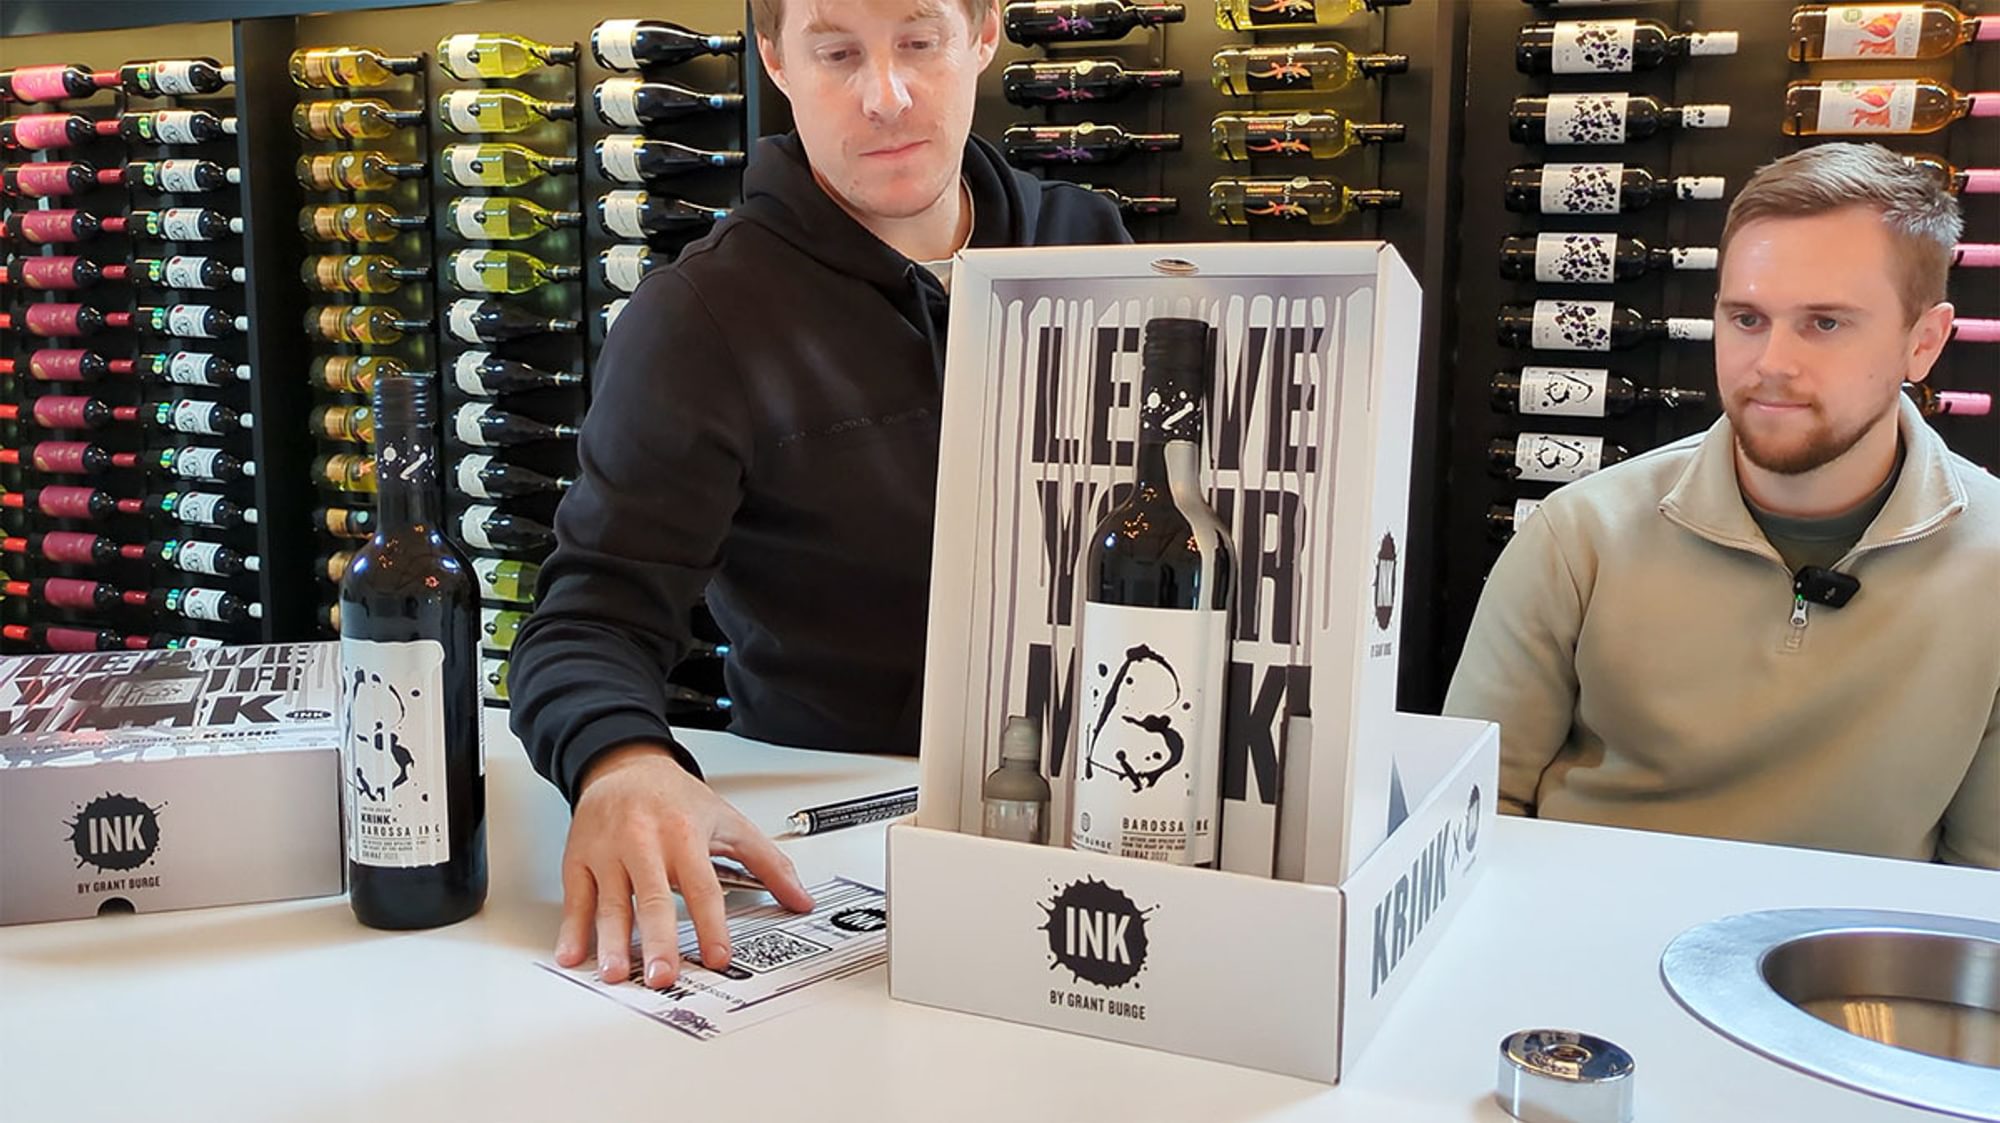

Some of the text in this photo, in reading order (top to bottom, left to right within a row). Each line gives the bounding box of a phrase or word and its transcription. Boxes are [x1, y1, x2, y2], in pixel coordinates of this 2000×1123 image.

[1032, 327, 1324, 472] LEVE
[1037, 480, 1305, 646] YR
[1025, 643, 1288, 806] MK
[89, 814, 147, 855] INK
[361, 813, 392, 825] KRINK
[361, 824, 412, 837] BAROSSA
[1122, 817, 1185, 832] BAROSSA
[77, 876, 161, 894] BY GRANT BURGE
[838, 911, 883, 931] INK
[1370, 818, 1450, 1000] KRINK
[1065, 906, 1132, 966] INK
[1049, 989, 1147, 1020] BY GRANT BURGE
